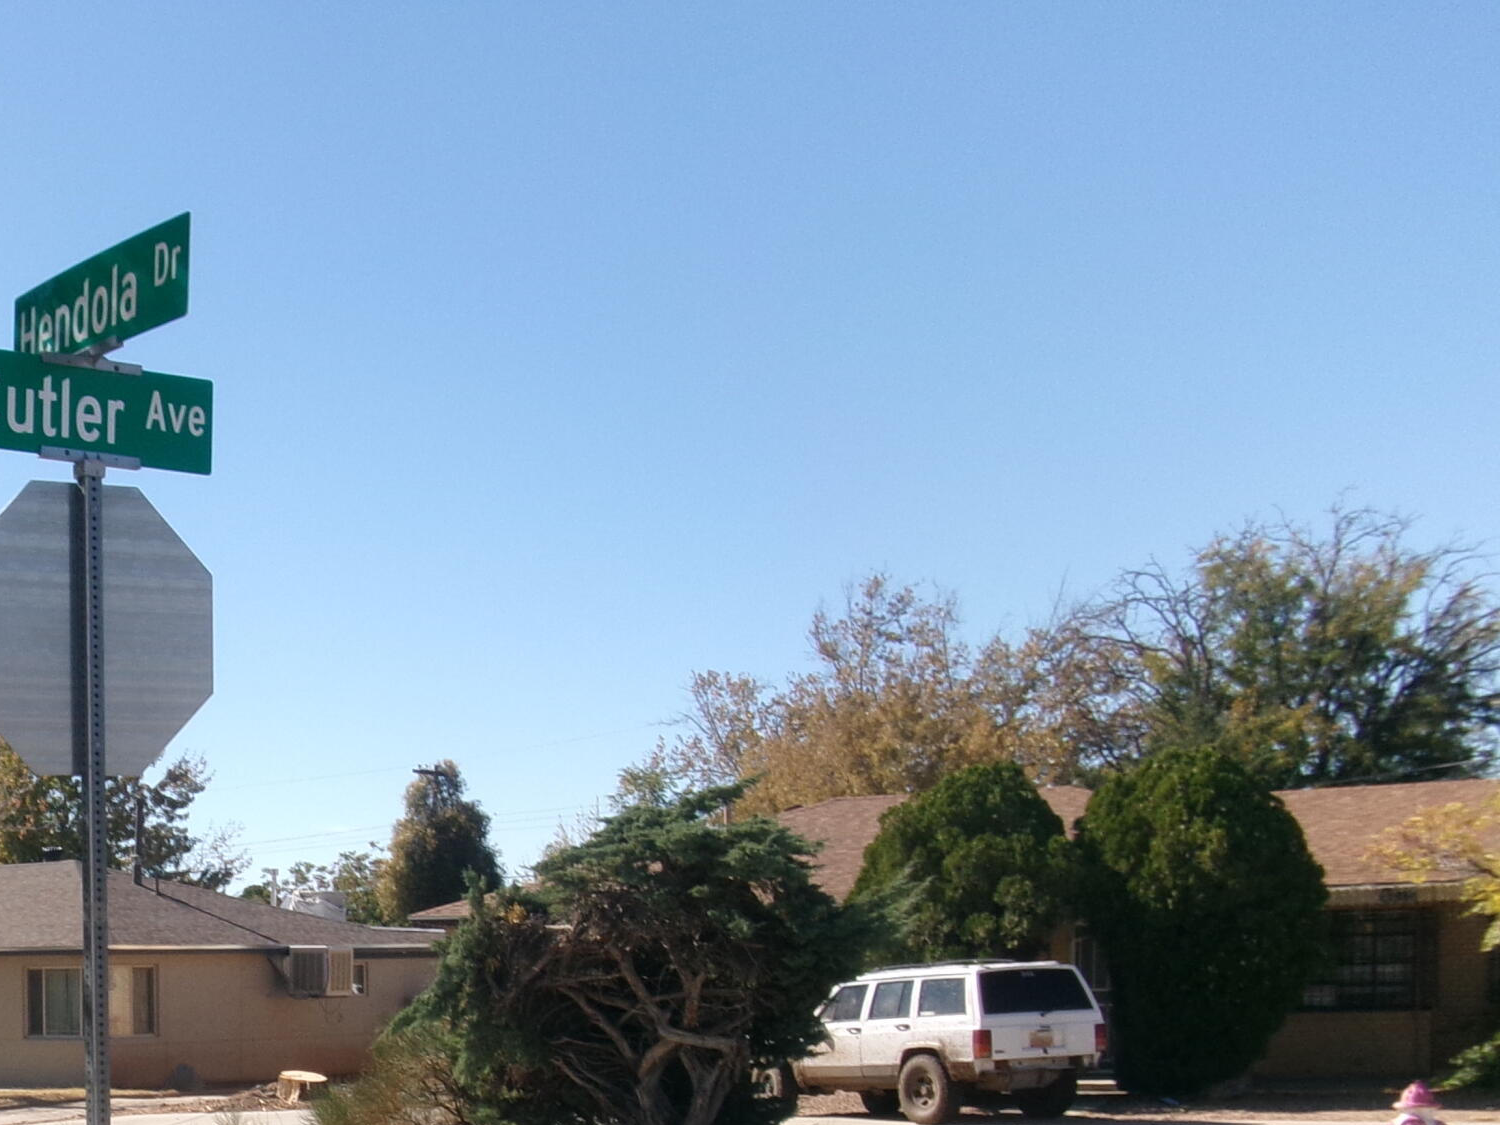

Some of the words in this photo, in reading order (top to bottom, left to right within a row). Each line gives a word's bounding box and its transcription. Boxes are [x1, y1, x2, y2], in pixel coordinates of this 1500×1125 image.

[20, 264, 138, 353] Hendola
[153, 242, 182, 287] Dr
[145, 390, 206, 437] Ave
